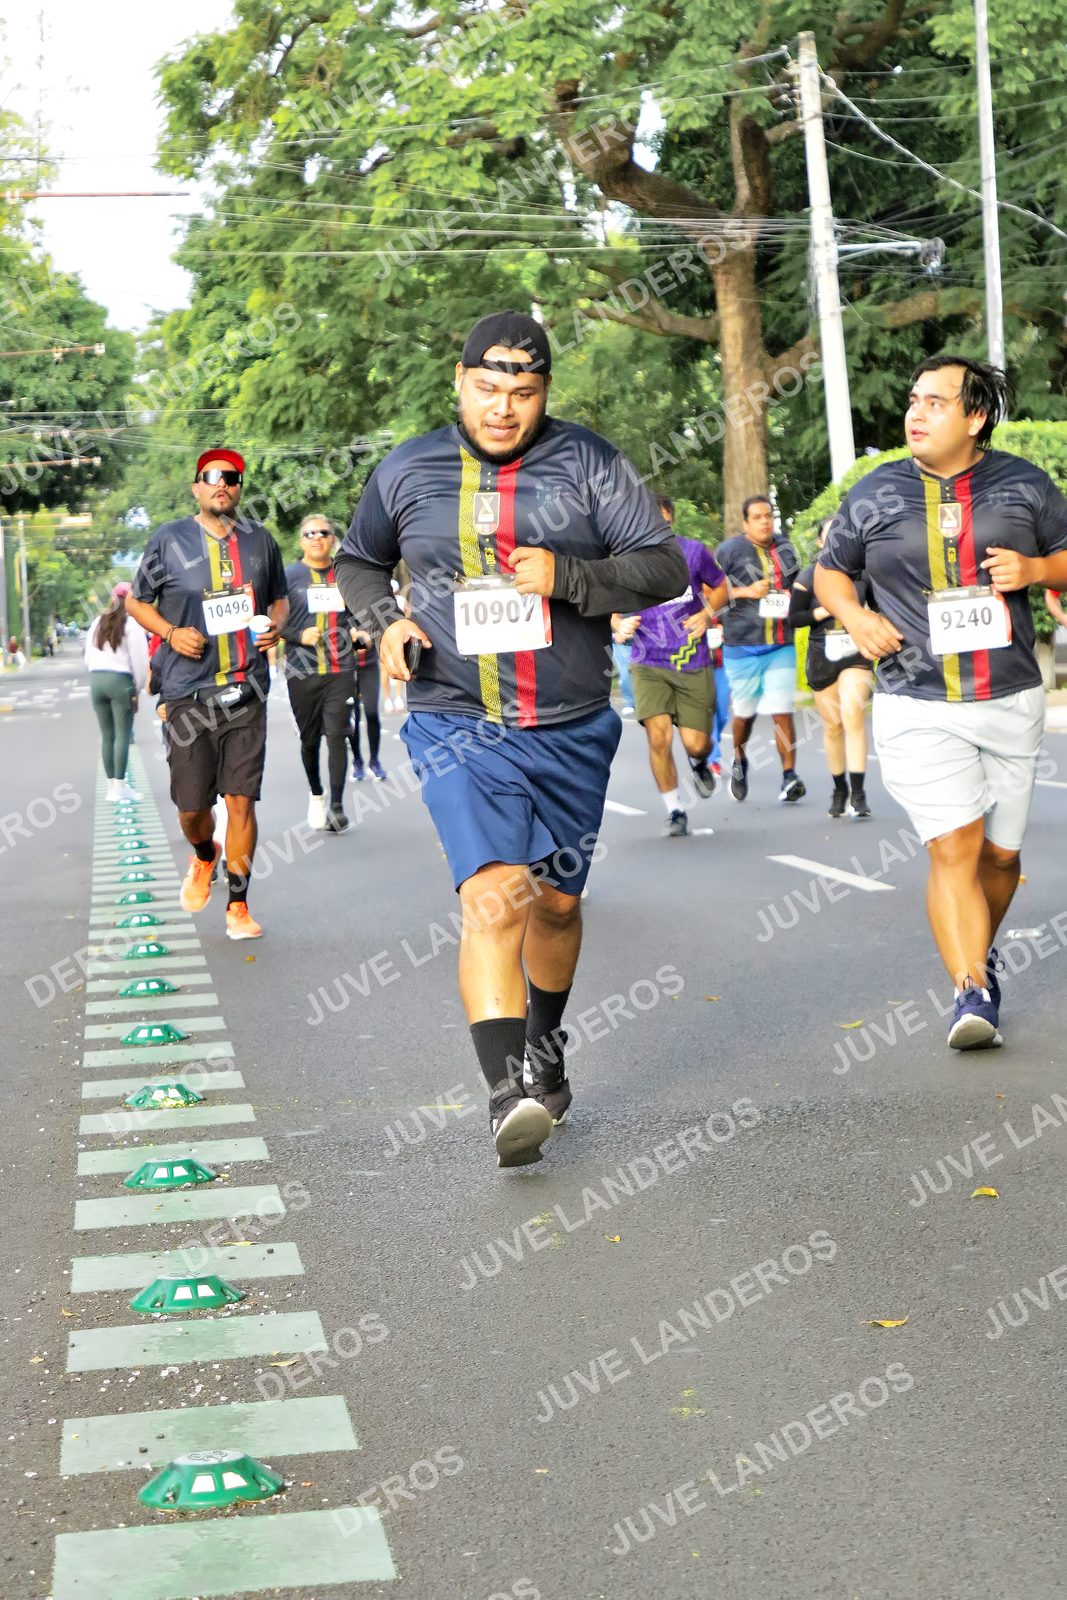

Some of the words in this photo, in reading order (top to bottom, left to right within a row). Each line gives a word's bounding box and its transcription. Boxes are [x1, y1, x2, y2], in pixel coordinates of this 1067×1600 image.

[208, 599, 250, 619] 10496
[460, 598, 535, 626] 10907
[941, 606, 992, 630] 9240
